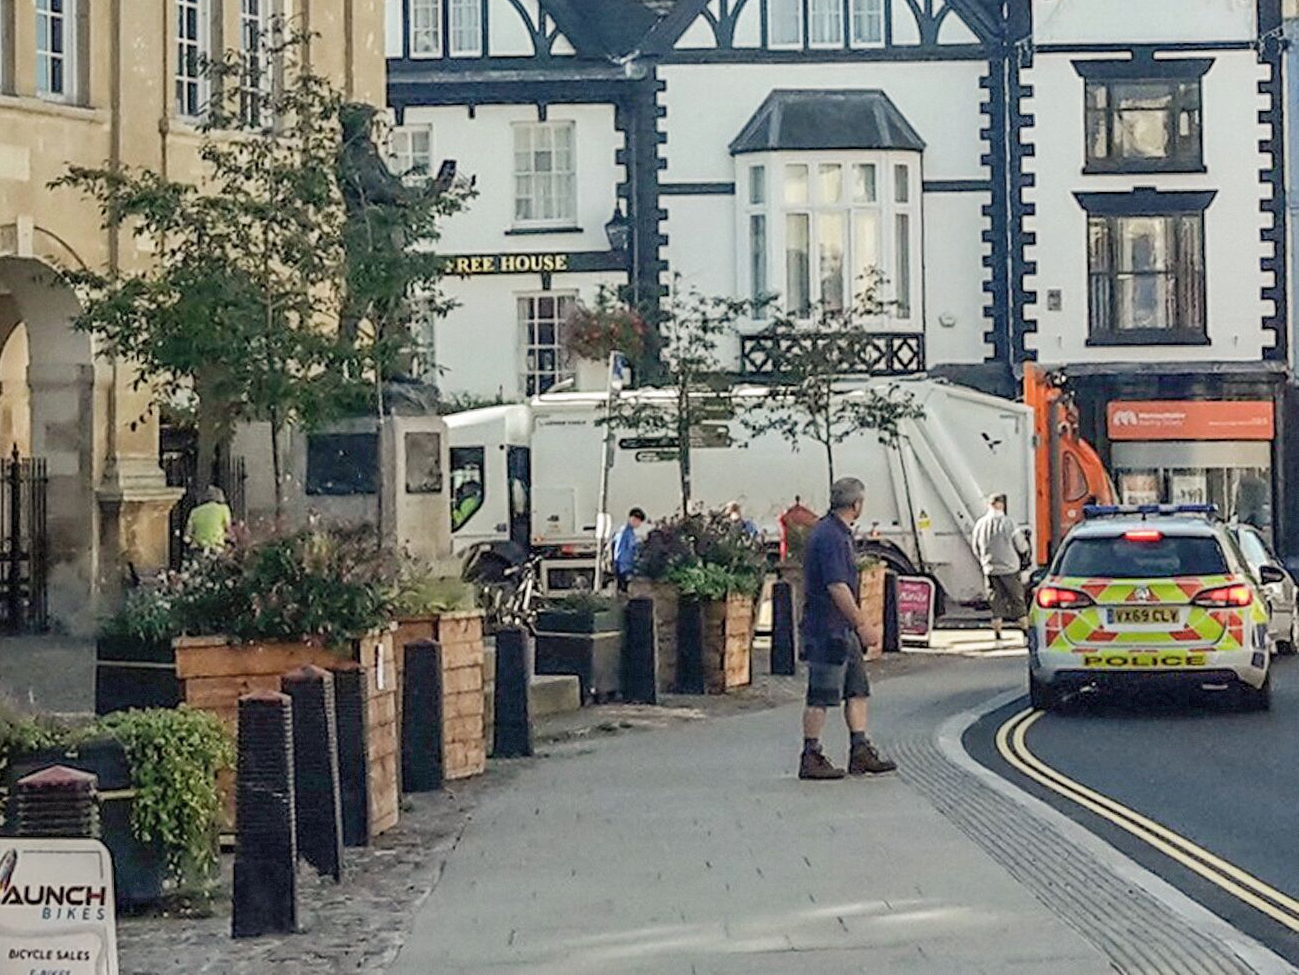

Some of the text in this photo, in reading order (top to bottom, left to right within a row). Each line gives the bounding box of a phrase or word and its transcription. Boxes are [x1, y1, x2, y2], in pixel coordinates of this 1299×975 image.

[501, 254, 568, 272] HOUSE
[1084, 655, 1206, 667] POLICE
[41, 906, 106, 921] BIKES
[7, 948, 91, 962] BICYCLE SALES
